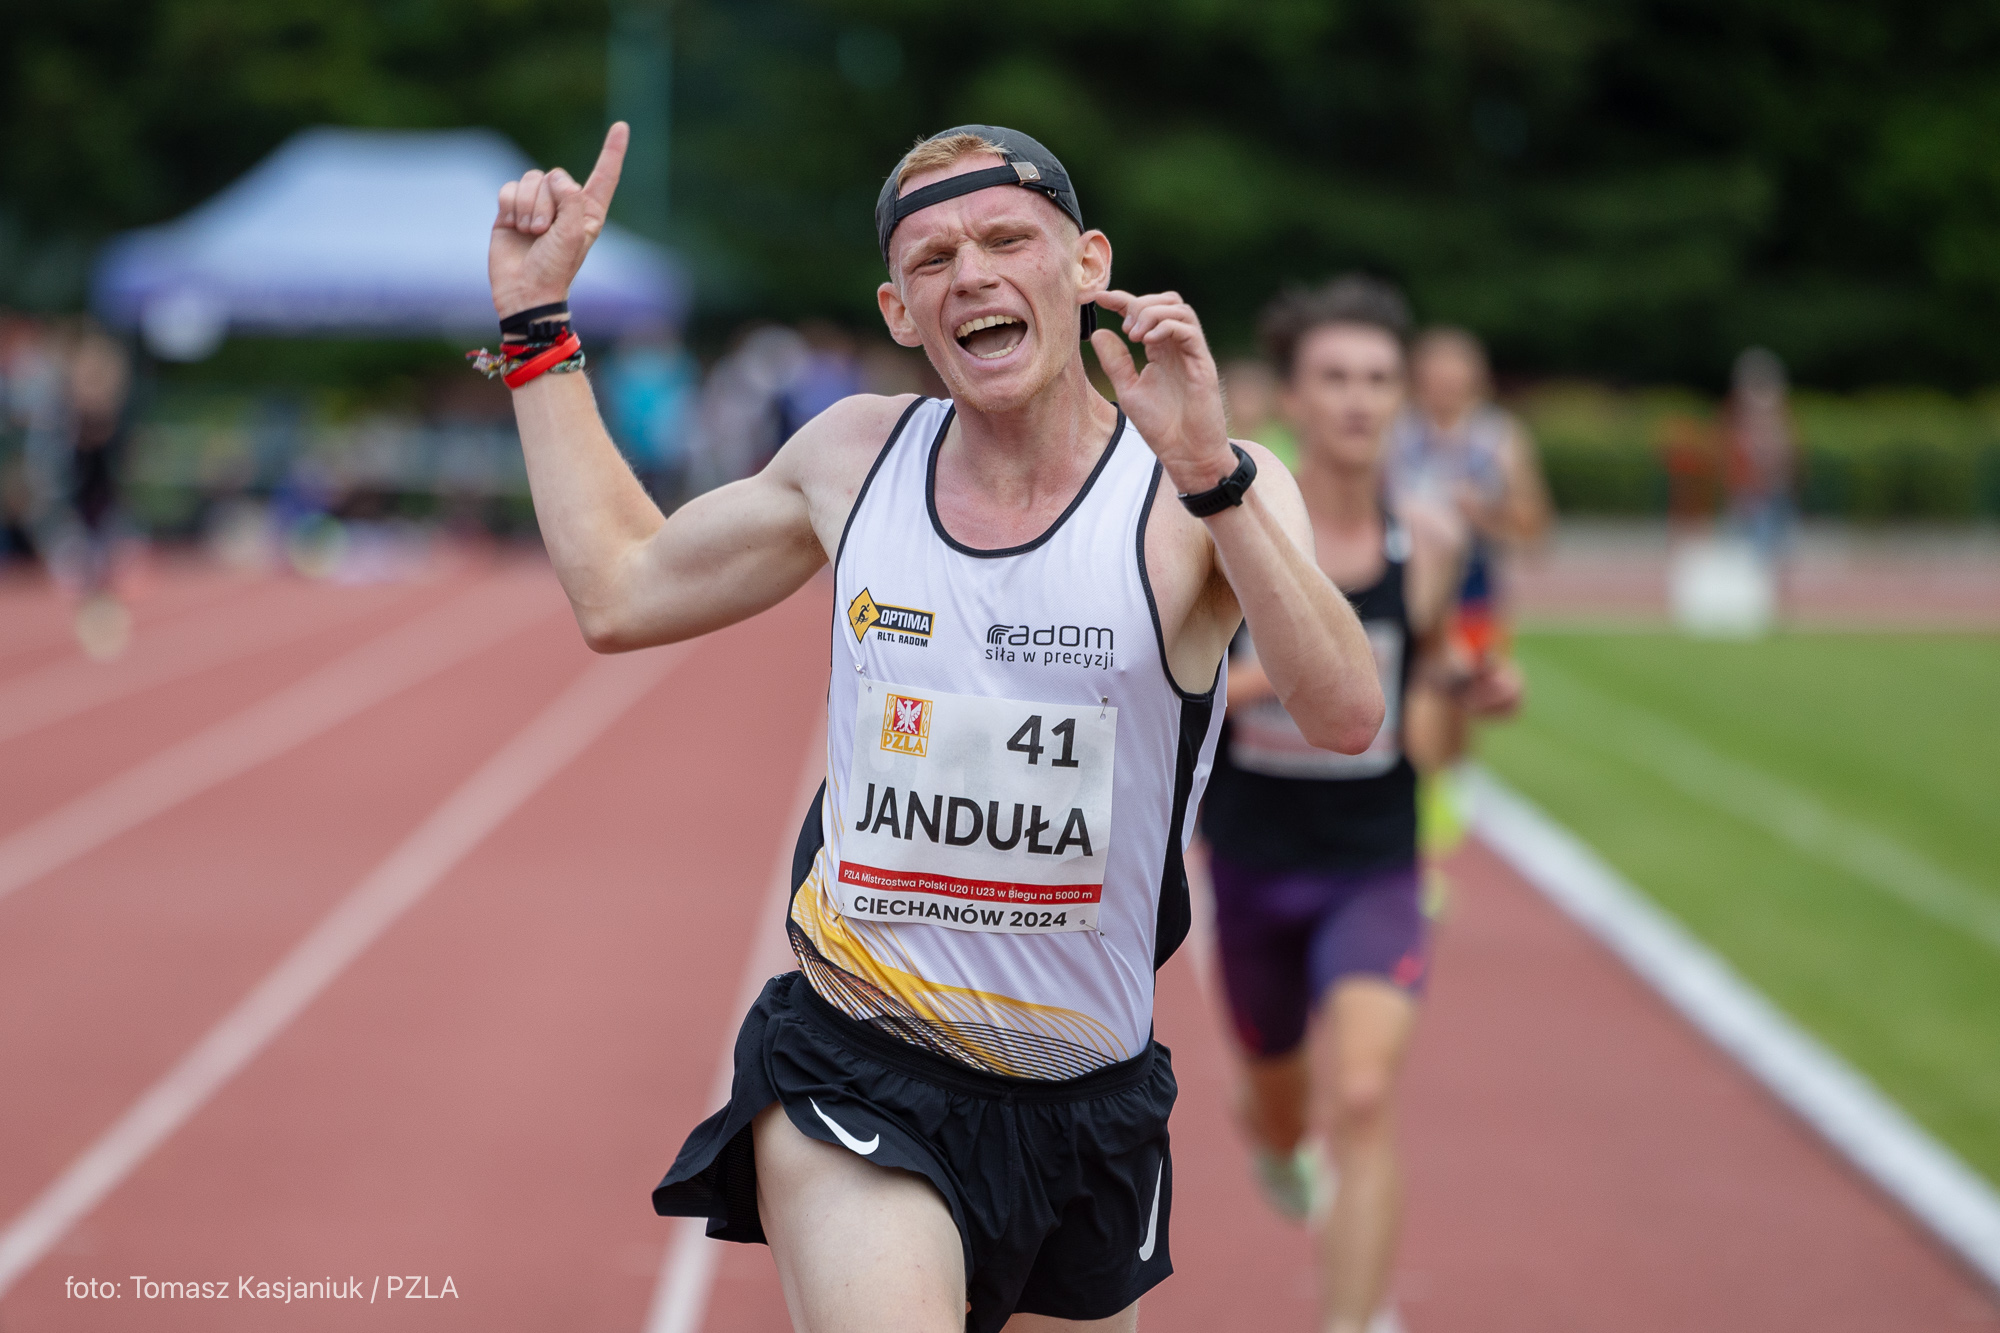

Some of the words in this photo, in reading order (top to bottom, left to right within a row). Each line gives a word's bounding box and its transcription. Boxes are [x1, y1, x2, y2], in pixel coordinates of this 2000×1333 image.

[880, 609, 930, 632] OPTIMA
[877, 631, 895, 643] RLTL
[898, 634, 928, 648] RADOM
[987, 624, 1114, 650] radom
[985, 647, 1015, 662] siła
[1023, 651, 1036, 662] w
[1044, 650, 1114, 670] precyzji
[883, 734, 924, 754] PZLA
[1006, 714, 1079, 768] 41
[855, 783, 1093, 857] JANDUŁA
[844, 869, 860, 881] PZLA
[861, 873, 916, 888] Mistrzostwa
[918, 879, 947, 891] Polski
[949, 884, 969, 895] U20
[975, 886, 995, 897] U23
[997, 890, 1007, 898] w
[1008, 889, 1037, 902] Biegu
[1039, 892, 1053, 900] na
[1055, 891, 1080, 900] 5000
[1082, 891, 1093, 899] m
[854, 895, 1004, 926] CIECHANÓW
[1009, 911, 1067, 928] 2024
